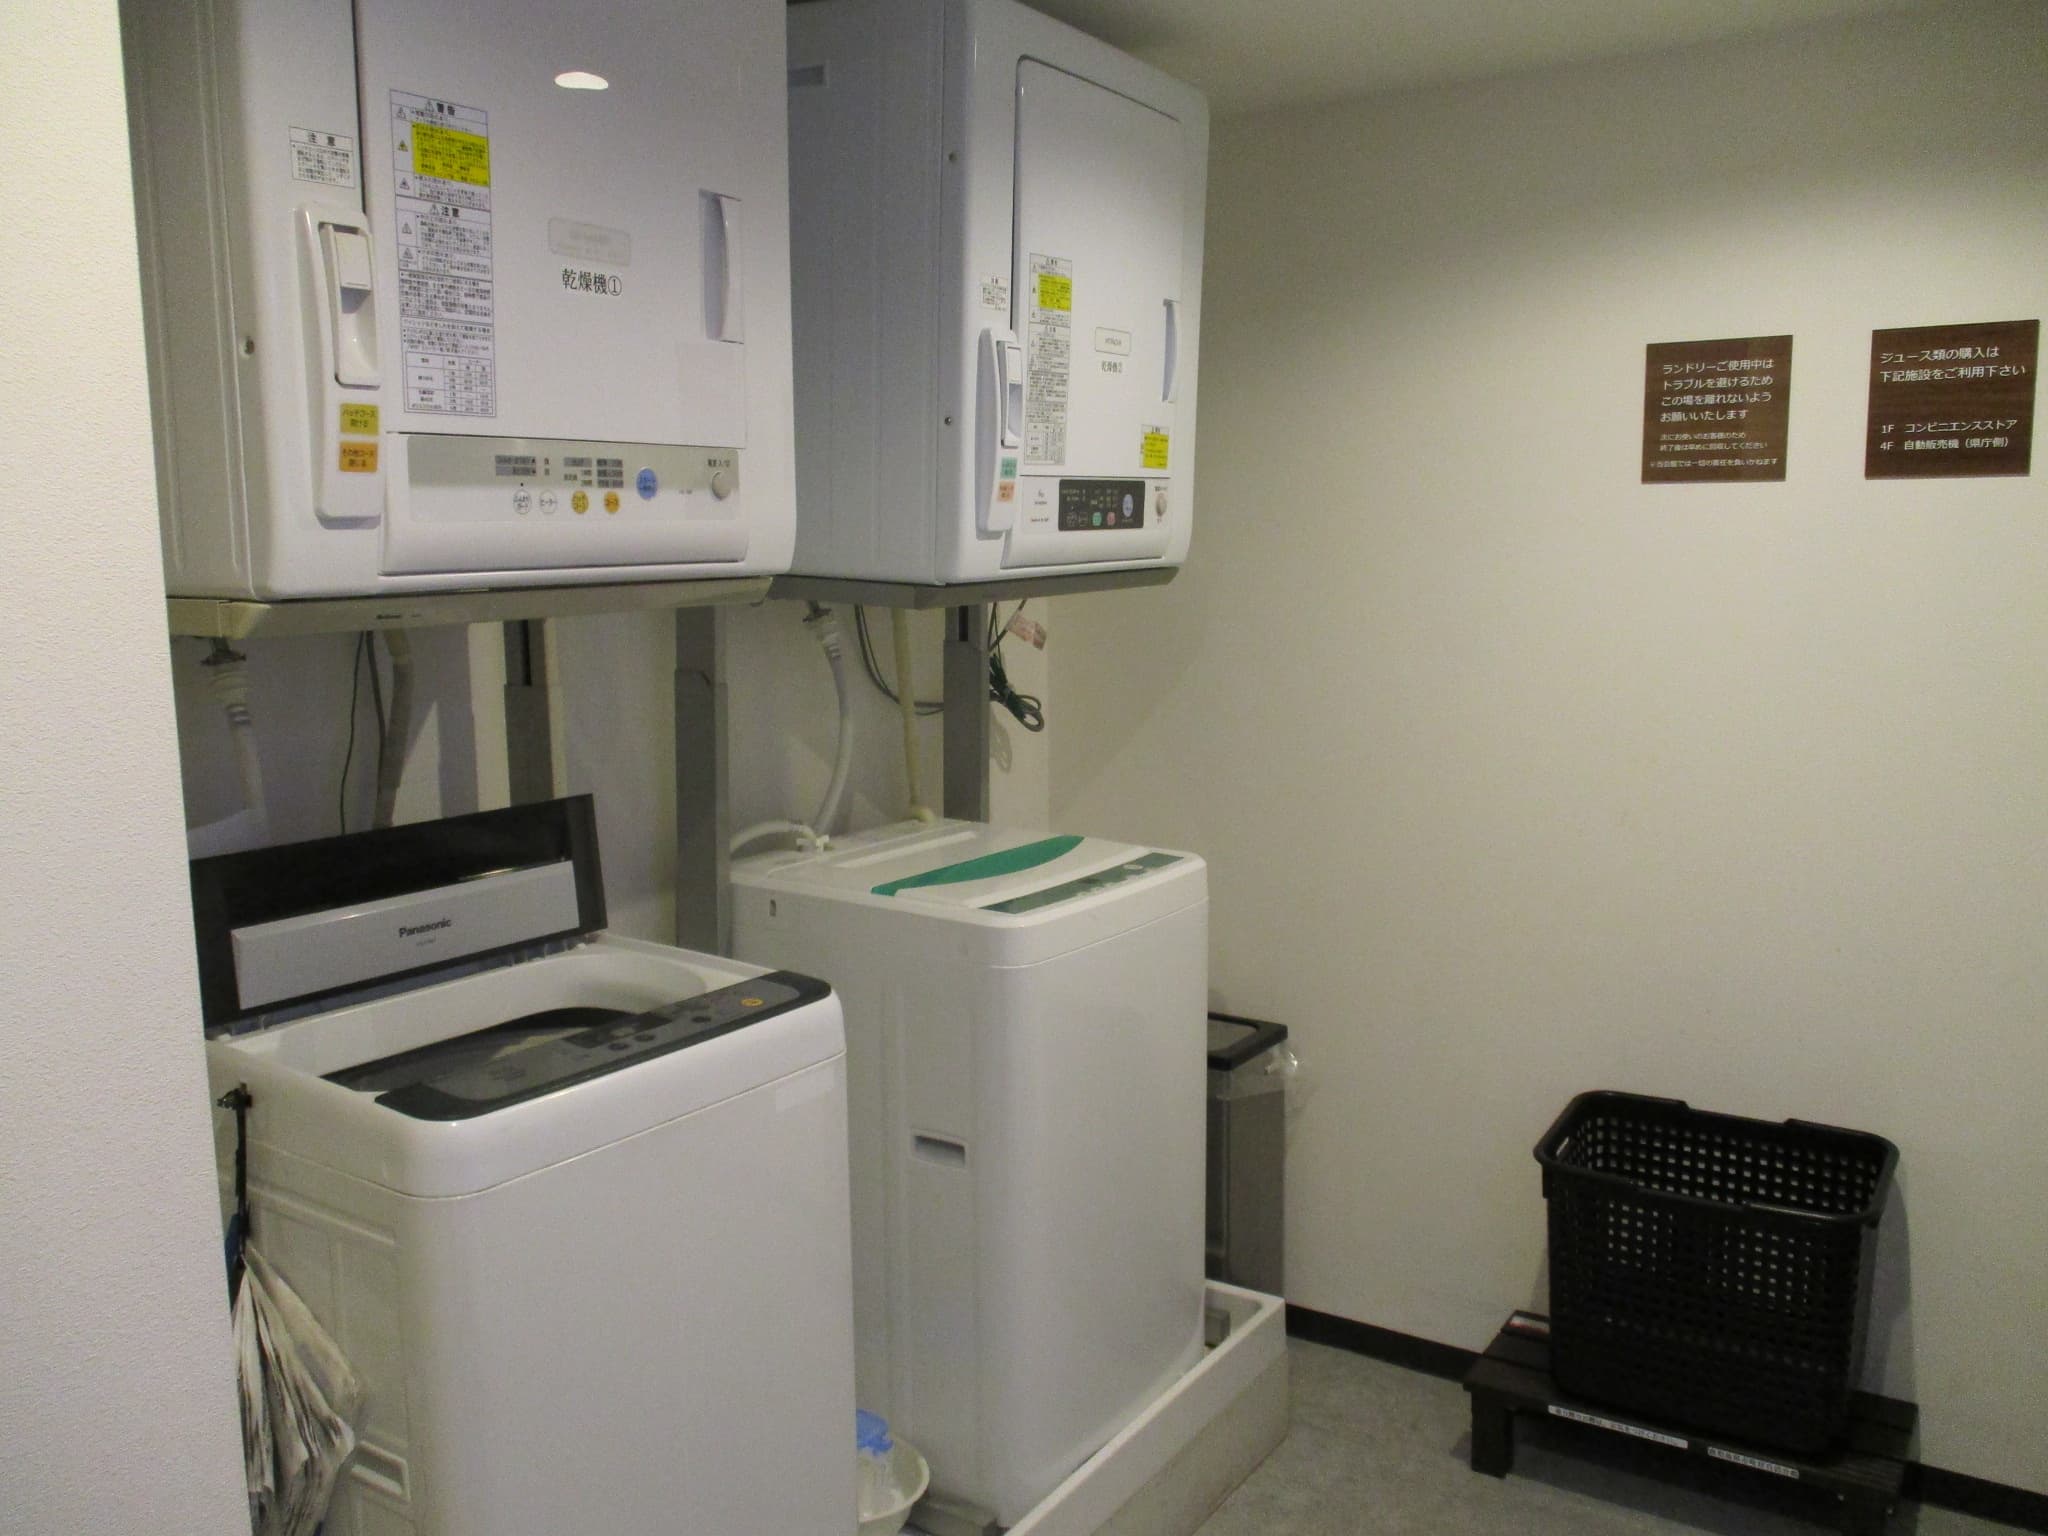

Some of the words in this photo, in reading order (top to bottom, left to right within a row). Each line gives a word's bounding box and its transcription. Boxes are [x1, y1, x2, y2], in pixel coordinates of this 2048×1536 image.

[561, 268, 622, 296] 乾燥機①
[1880, 346, 2000, 364] ジュース類の購入は
[1663, 359, 1775, 375] ランドリーご使用中は
[1880, 364, 2026, 383] 下記施設をご利用下さい
[1663, 375, 1773, 391] トラブルを避けるため
[1661, 391, 1772, 406] この場を離れないよう
[1660, 409, 1748, 423] お願いいたします
[1881, 424, 1895, 434] 1F
[1904, 418, 2018, 433] コンビニエンスストア
[1879, 441, 1894, 451] 4F
[399, 918, 452, 938] Panasonic
